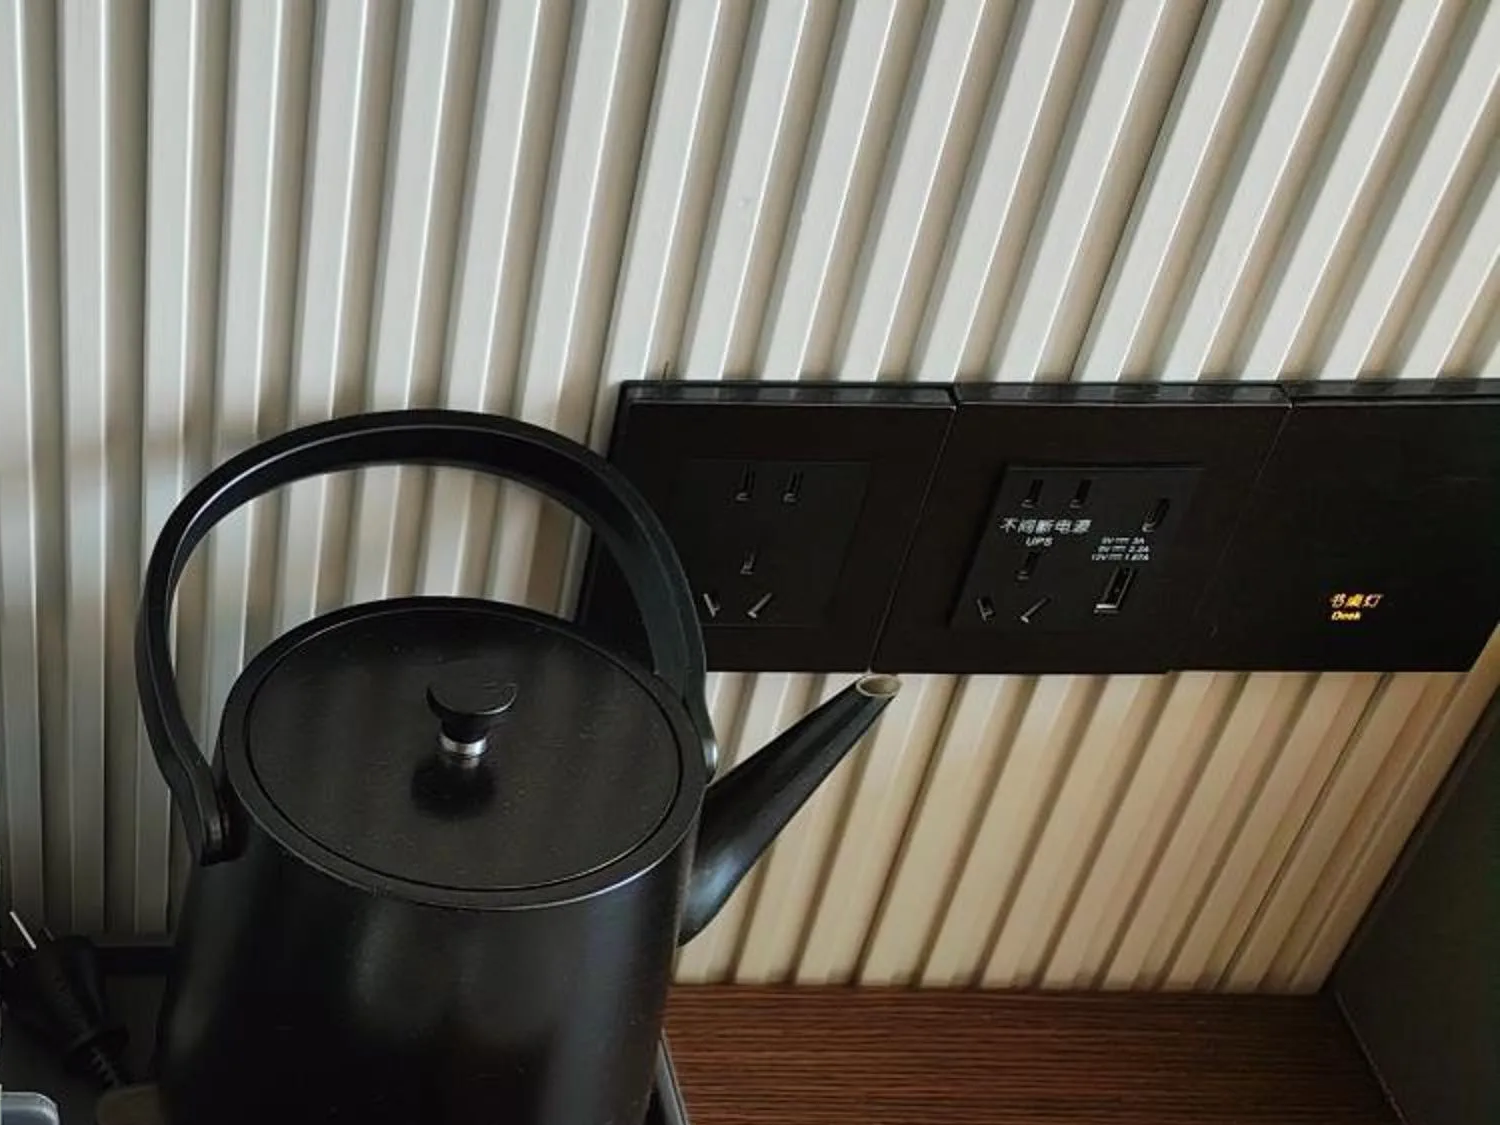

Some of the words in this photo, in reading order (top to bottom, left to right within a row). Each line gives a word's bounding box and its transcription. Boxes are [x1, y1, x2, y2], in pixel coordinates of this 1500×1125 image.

[999, 518, 1092, 534] 不间断电源
[1025, 536, 1053, 547] UPS
